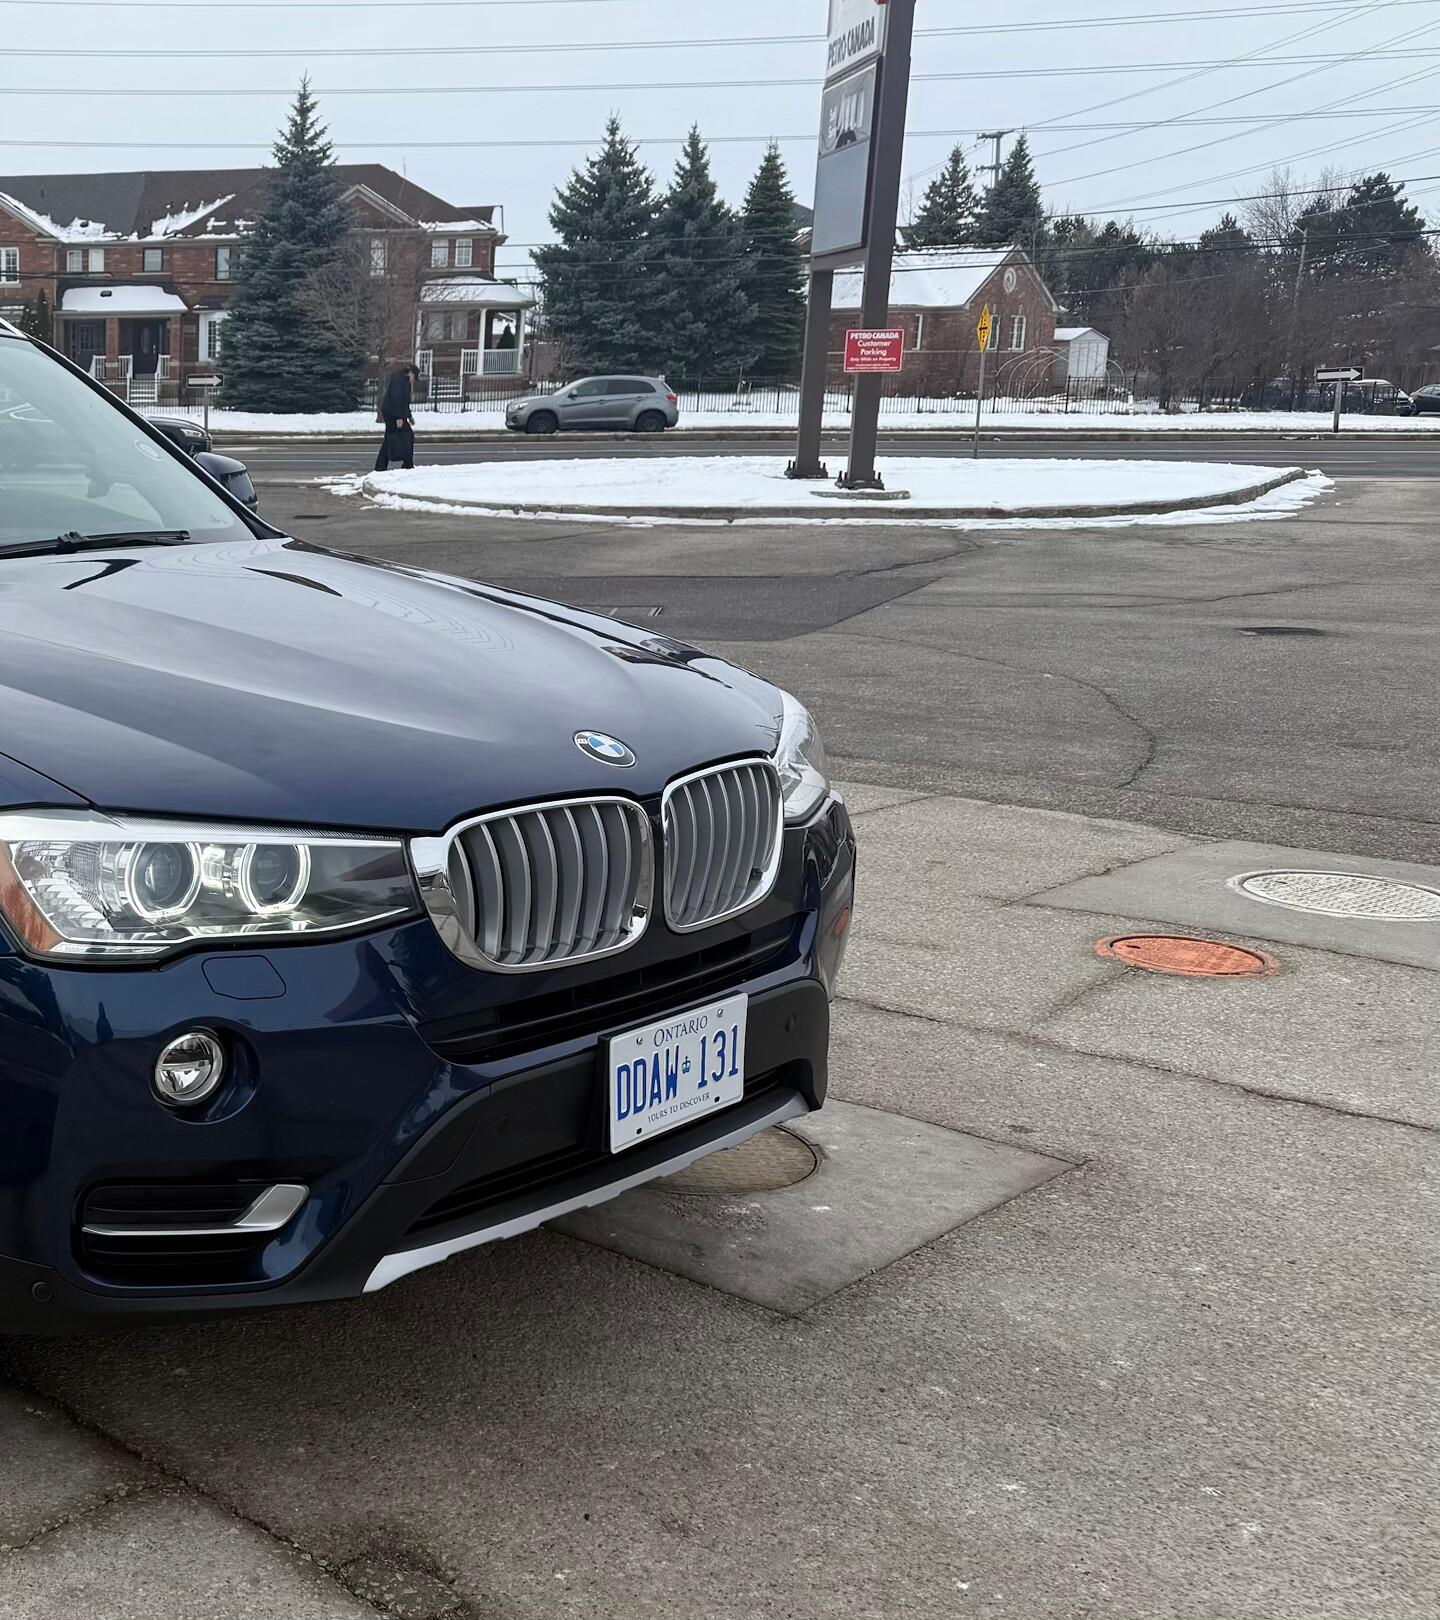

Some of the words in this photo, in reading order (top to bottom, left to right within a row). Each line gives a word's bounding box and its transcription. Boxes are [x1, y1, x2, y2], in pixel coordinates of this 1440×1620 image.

[860, 348, 887, 356] Parking
[654, 1015, 708, 1047] ONTARIO
[617, 1045, 680, 1121] DDAW
[697, 1024, 739, 1089] 131
[648, 1110, 668, 1123] YOURS
[670, 1106, 678, 1114] TO
[679, 1092, 710, 1111] DISCOVER
